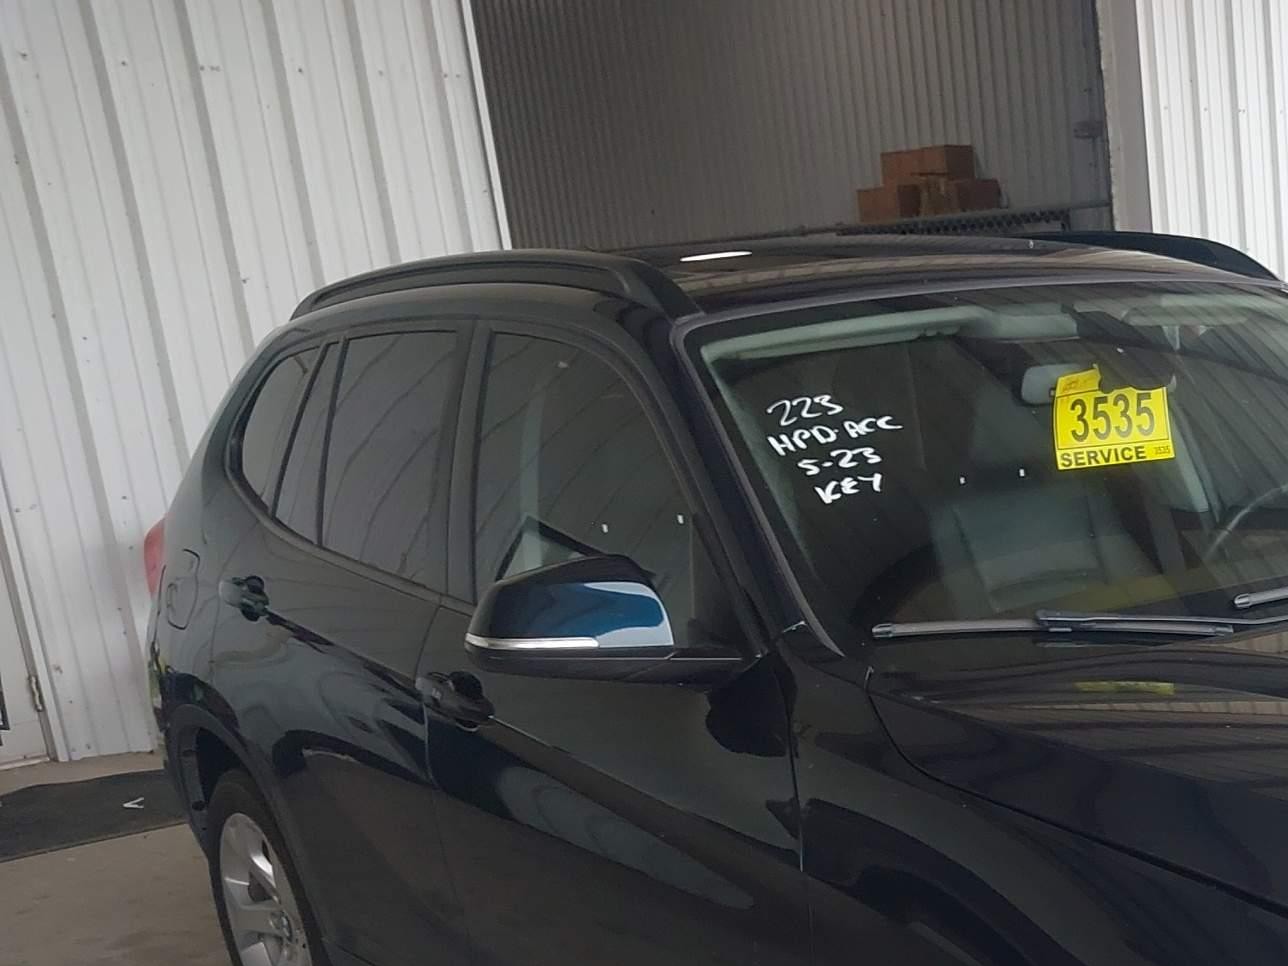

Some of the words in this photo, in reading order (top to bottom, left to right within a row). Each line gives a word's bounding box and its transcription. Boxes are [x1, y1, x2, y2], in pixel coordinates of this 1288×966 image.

[765, 394, 844, 426] 223
[1070, 392, 1155, 442] 3535
[797, 447, 882, 475] 5-23
[1060, 446, 1147, 468] SERVICE
[814, 472, 882, 504] KEY
